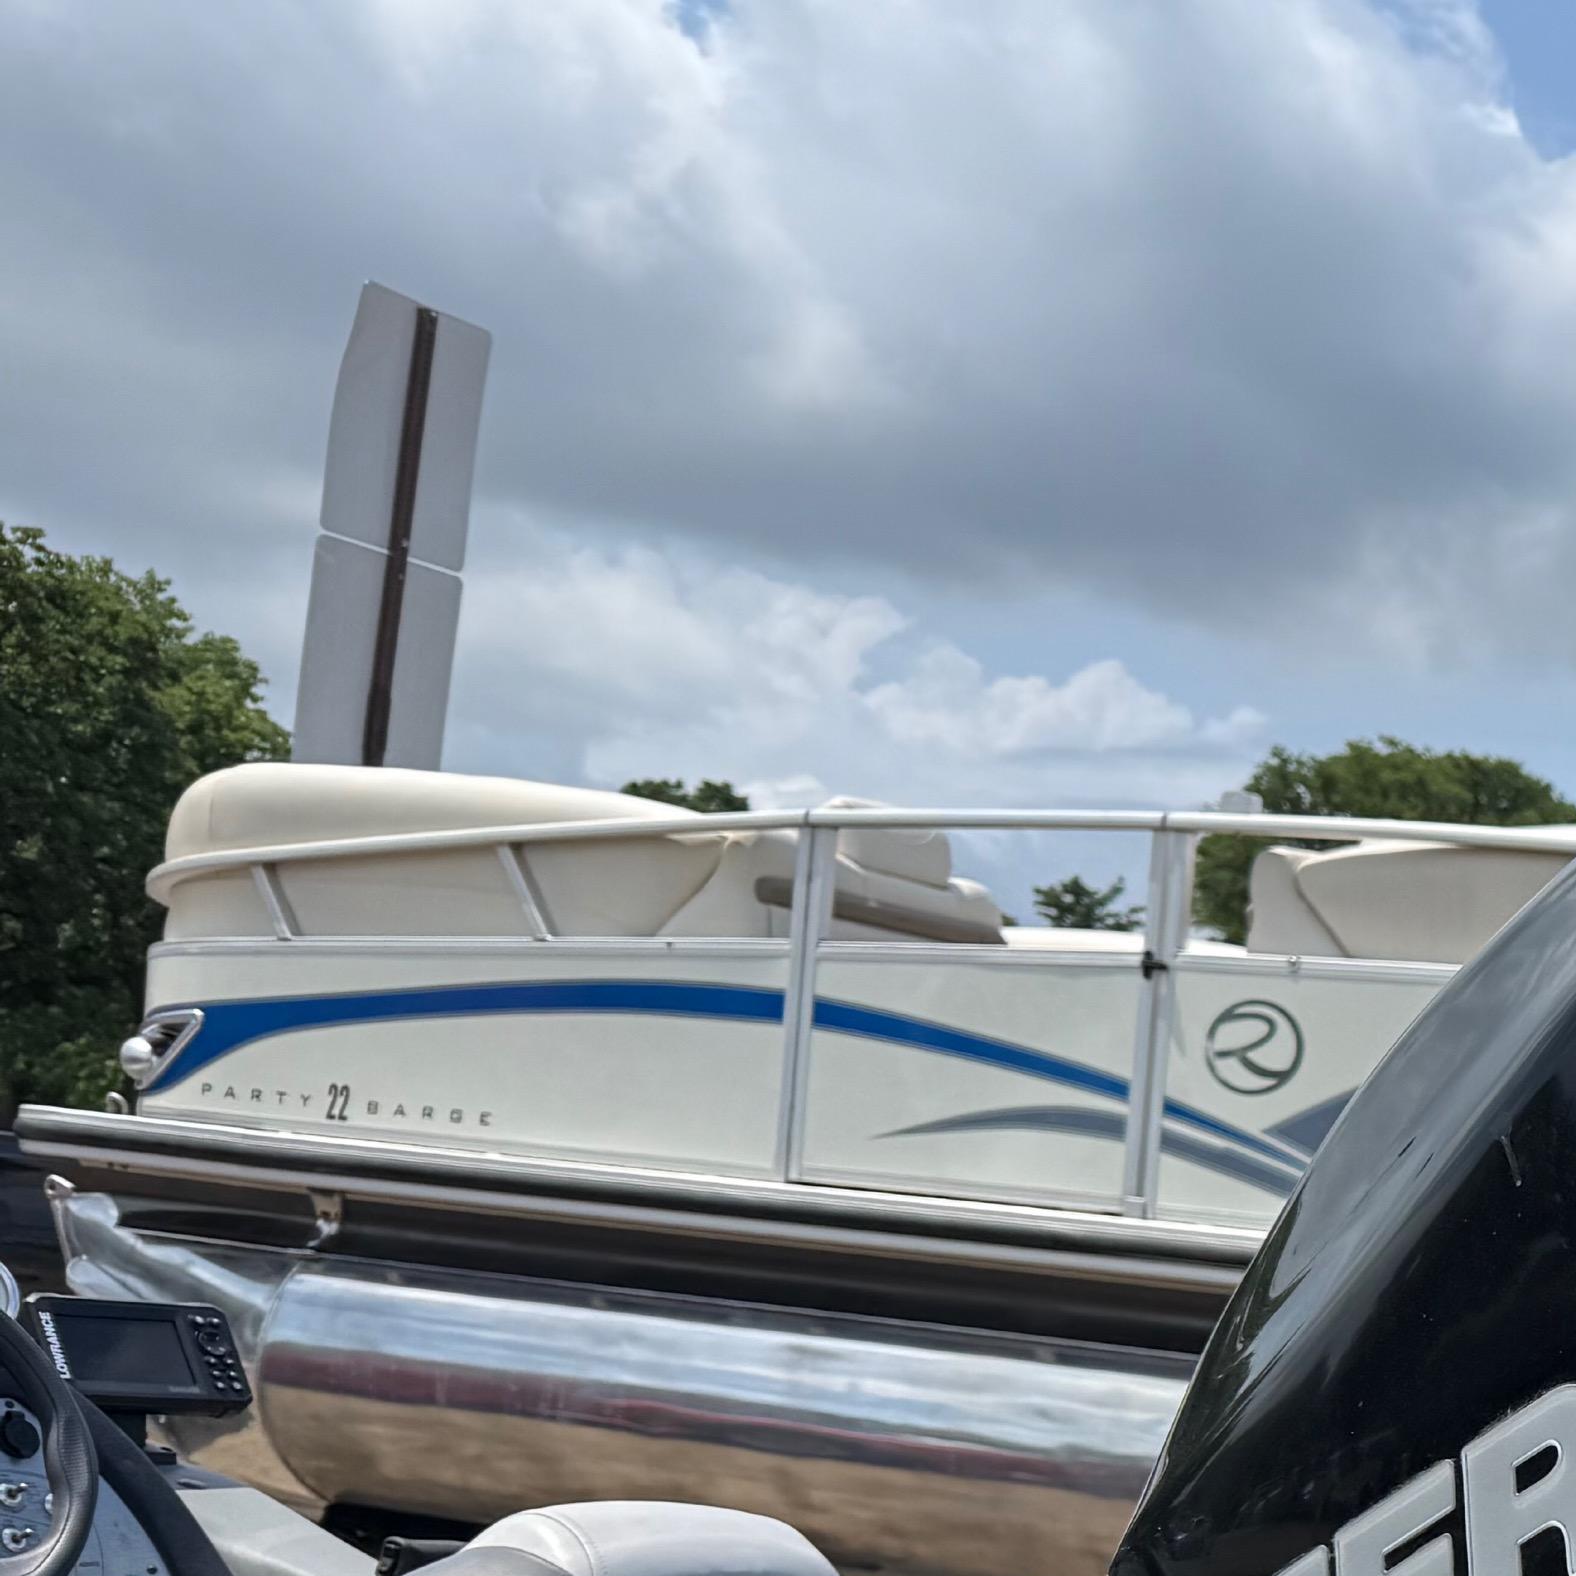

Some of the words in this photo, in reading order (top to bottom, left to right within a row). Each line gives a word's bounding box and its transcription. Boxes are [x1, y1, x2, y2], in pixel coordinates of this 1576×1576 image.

[200, 1082, 312, 1108] PARTY
[325, 1082, 351, 1121] 22
[366, 1100, 493, 1127] BARGE
[38, 1311, 72, 1380] LOWRANCE
